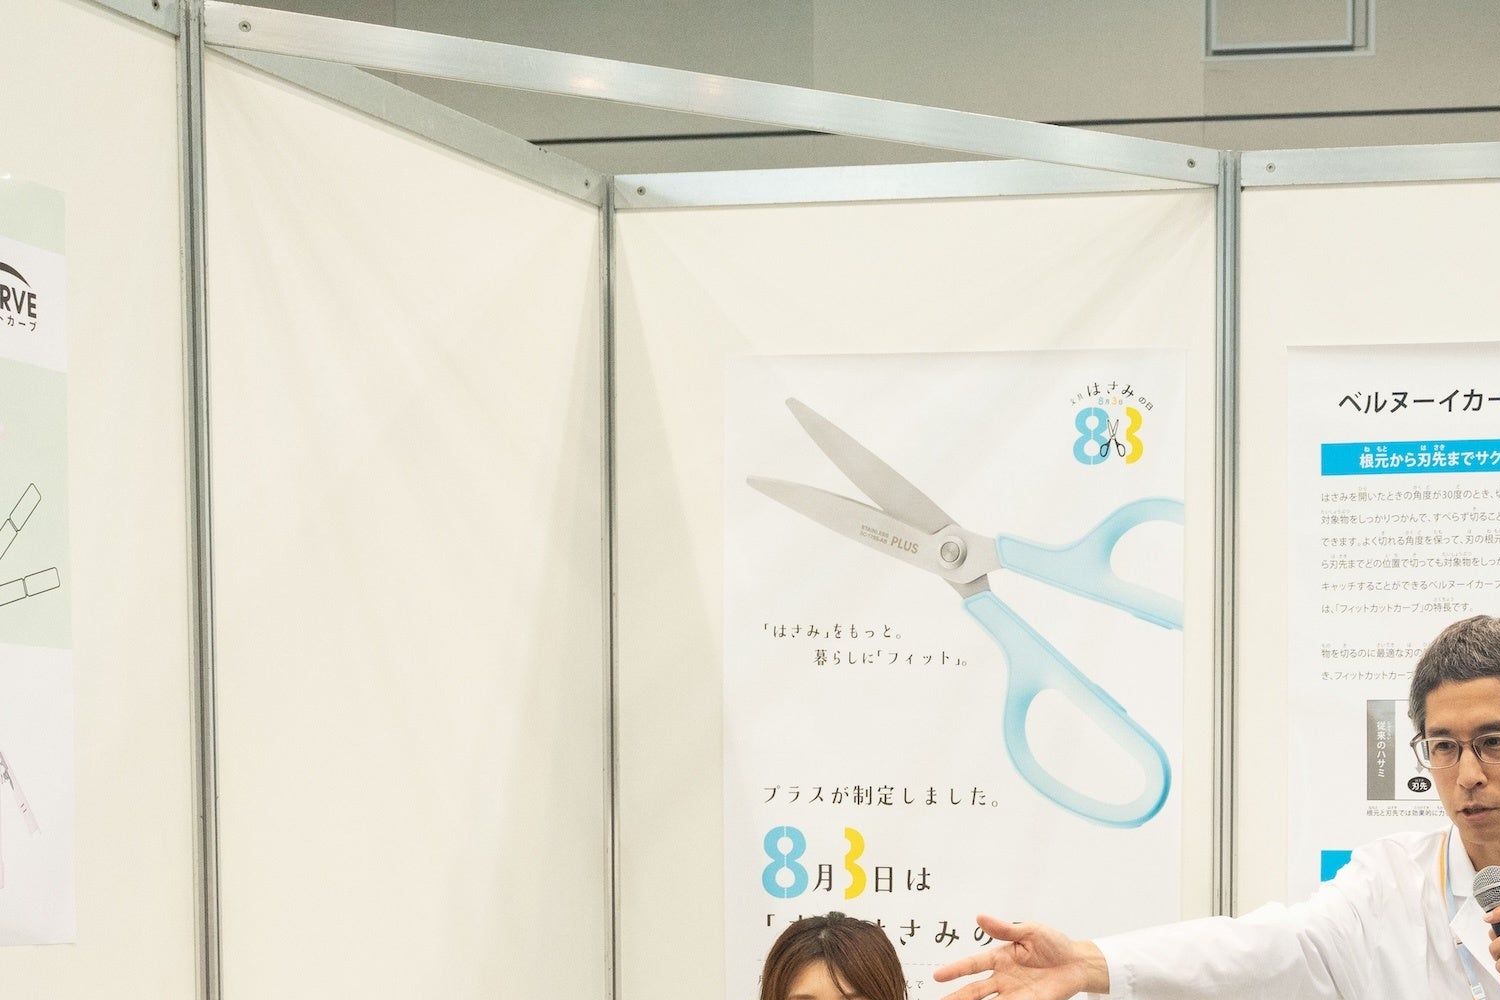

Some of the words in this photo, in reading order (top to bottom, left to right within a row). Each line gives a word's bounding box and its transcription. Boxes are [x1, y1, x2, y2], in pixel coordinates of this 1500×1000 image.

[890, 535, 919, 554] PLUS
[764, 623, 902, 639] 「はさみ」をもっと。
[814, 648, 968, 666] 暮らしに「フィット」。
[1376, 720, 1387, 778] 従来のハサミ
[763, 785, 999, 808] プラスが制定しました。
